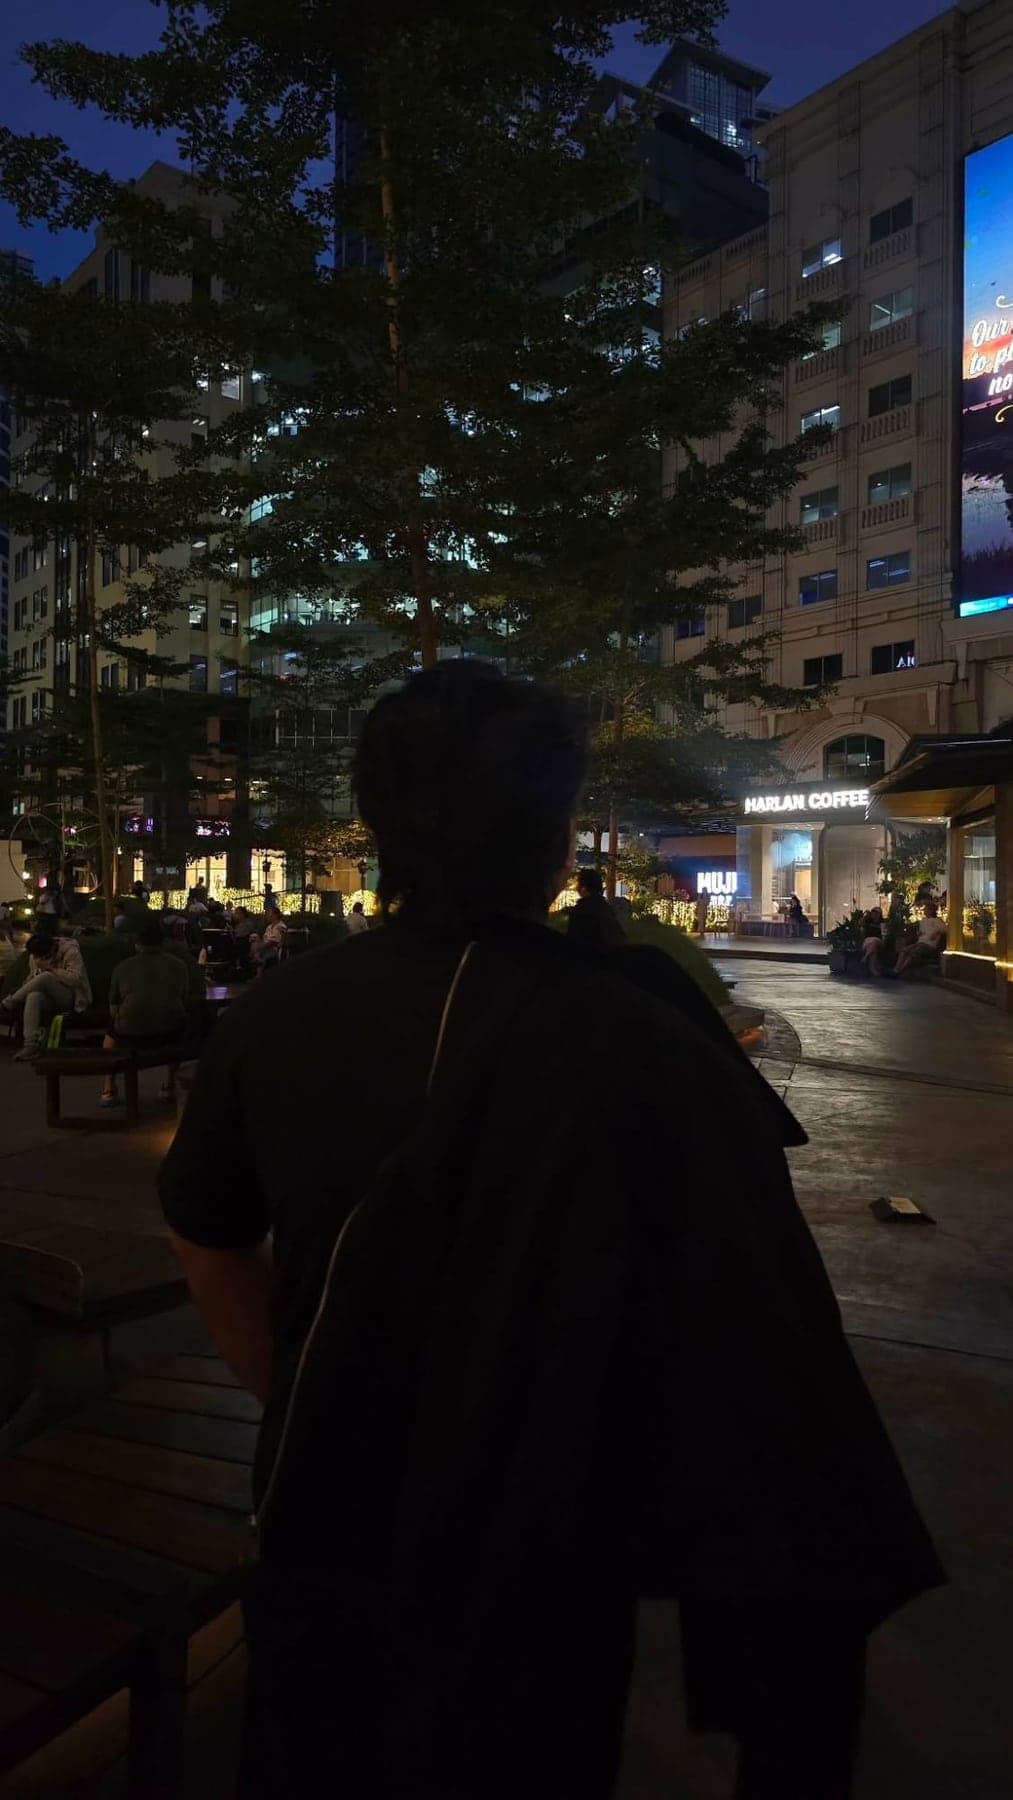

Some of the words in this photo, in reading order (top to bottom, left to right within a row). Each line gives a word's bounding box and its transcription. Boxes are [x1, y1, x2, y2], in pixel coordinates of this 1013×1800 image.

[972, 319, 1009, 347] Our
[969, 352, 987, 375] to
[743, 795, 804, 814] HARLAN
[807, 789, 869, 809] COFFEE
[697, 872, 737, 894] MUJI
